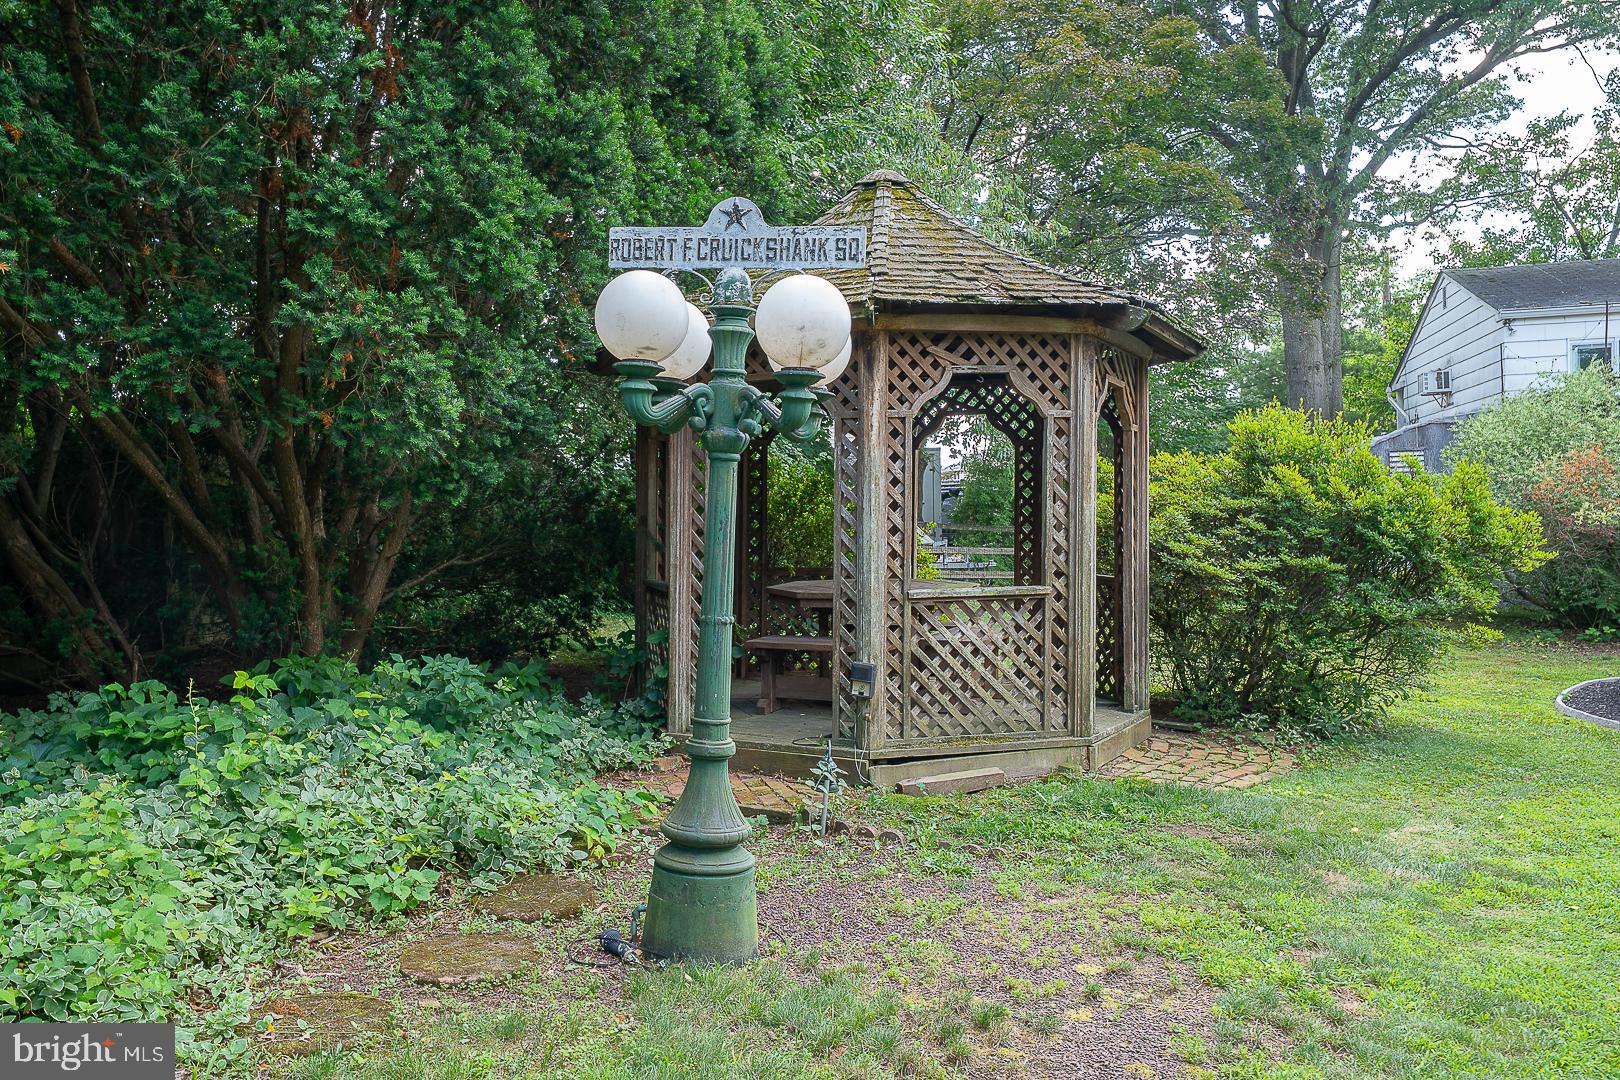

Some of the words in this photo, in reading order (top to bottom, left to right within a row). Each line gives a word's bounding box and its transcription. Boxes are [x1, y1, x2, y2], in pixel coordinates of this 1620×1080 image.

[610, 237, 677, 262] ROBERT
[683, 237, 692, 262] F.
[697, 237, 829, 263] CRUICKSHANK
[835, 237, 864, 263] SQ.
